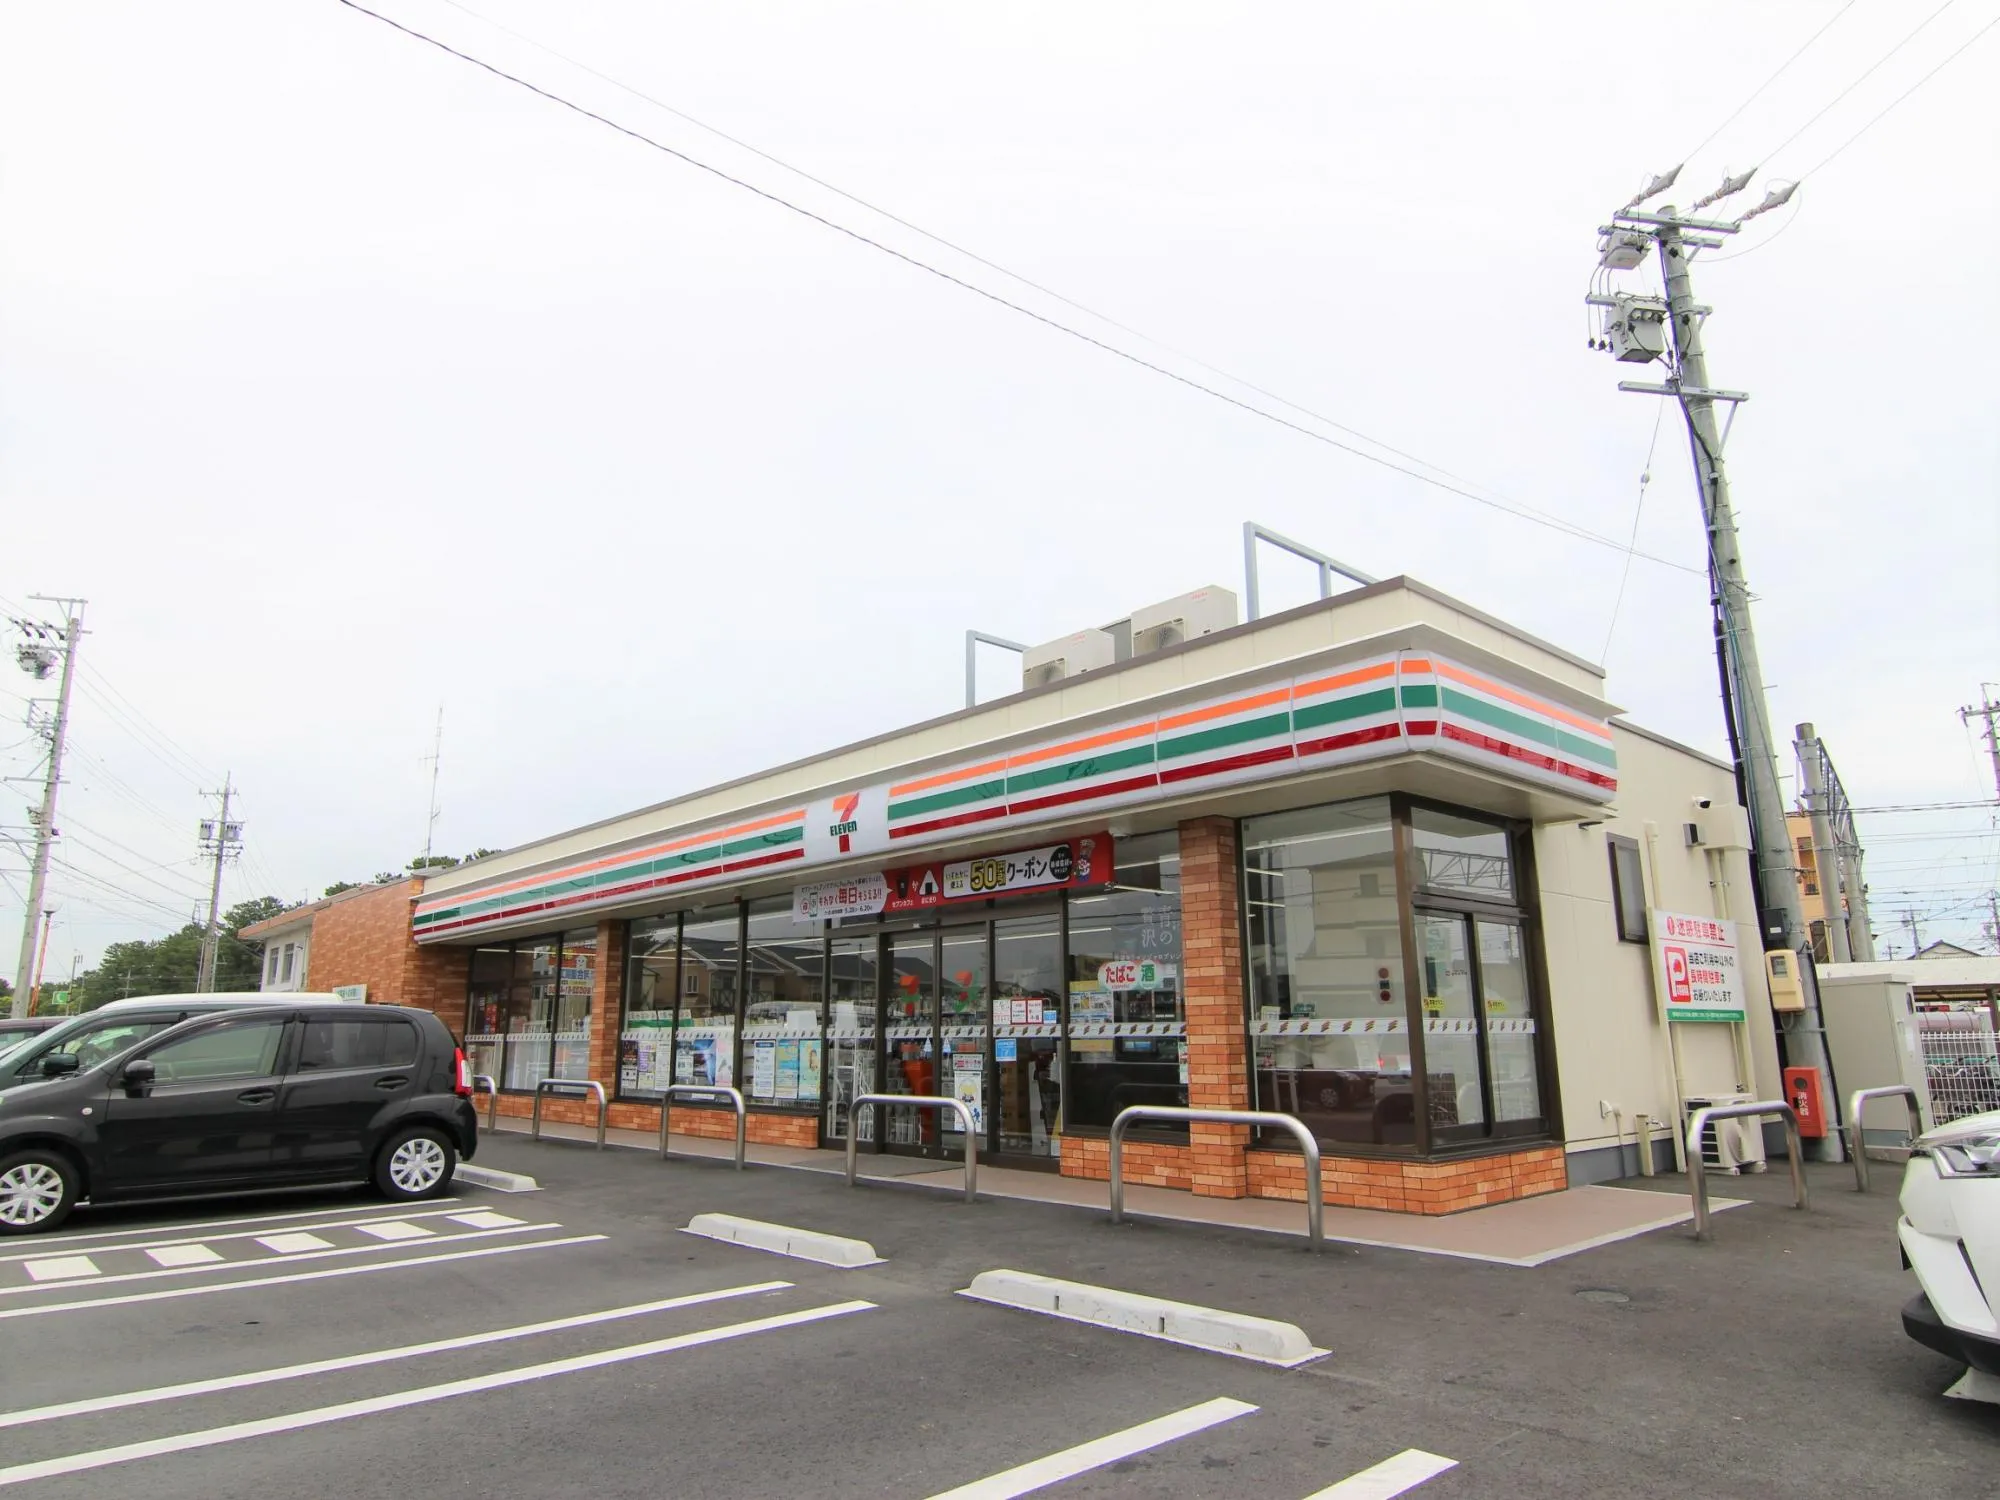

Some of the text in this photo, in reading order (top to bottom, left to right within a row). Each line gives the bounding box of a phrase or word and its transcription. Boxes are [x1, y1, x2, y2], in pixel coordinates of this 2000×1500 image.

[832, 792, 860, 853] 7
[1105, 964, 1155, 984] たばこ 酒
[1797, 1091, 1809, 1117] 消火器
